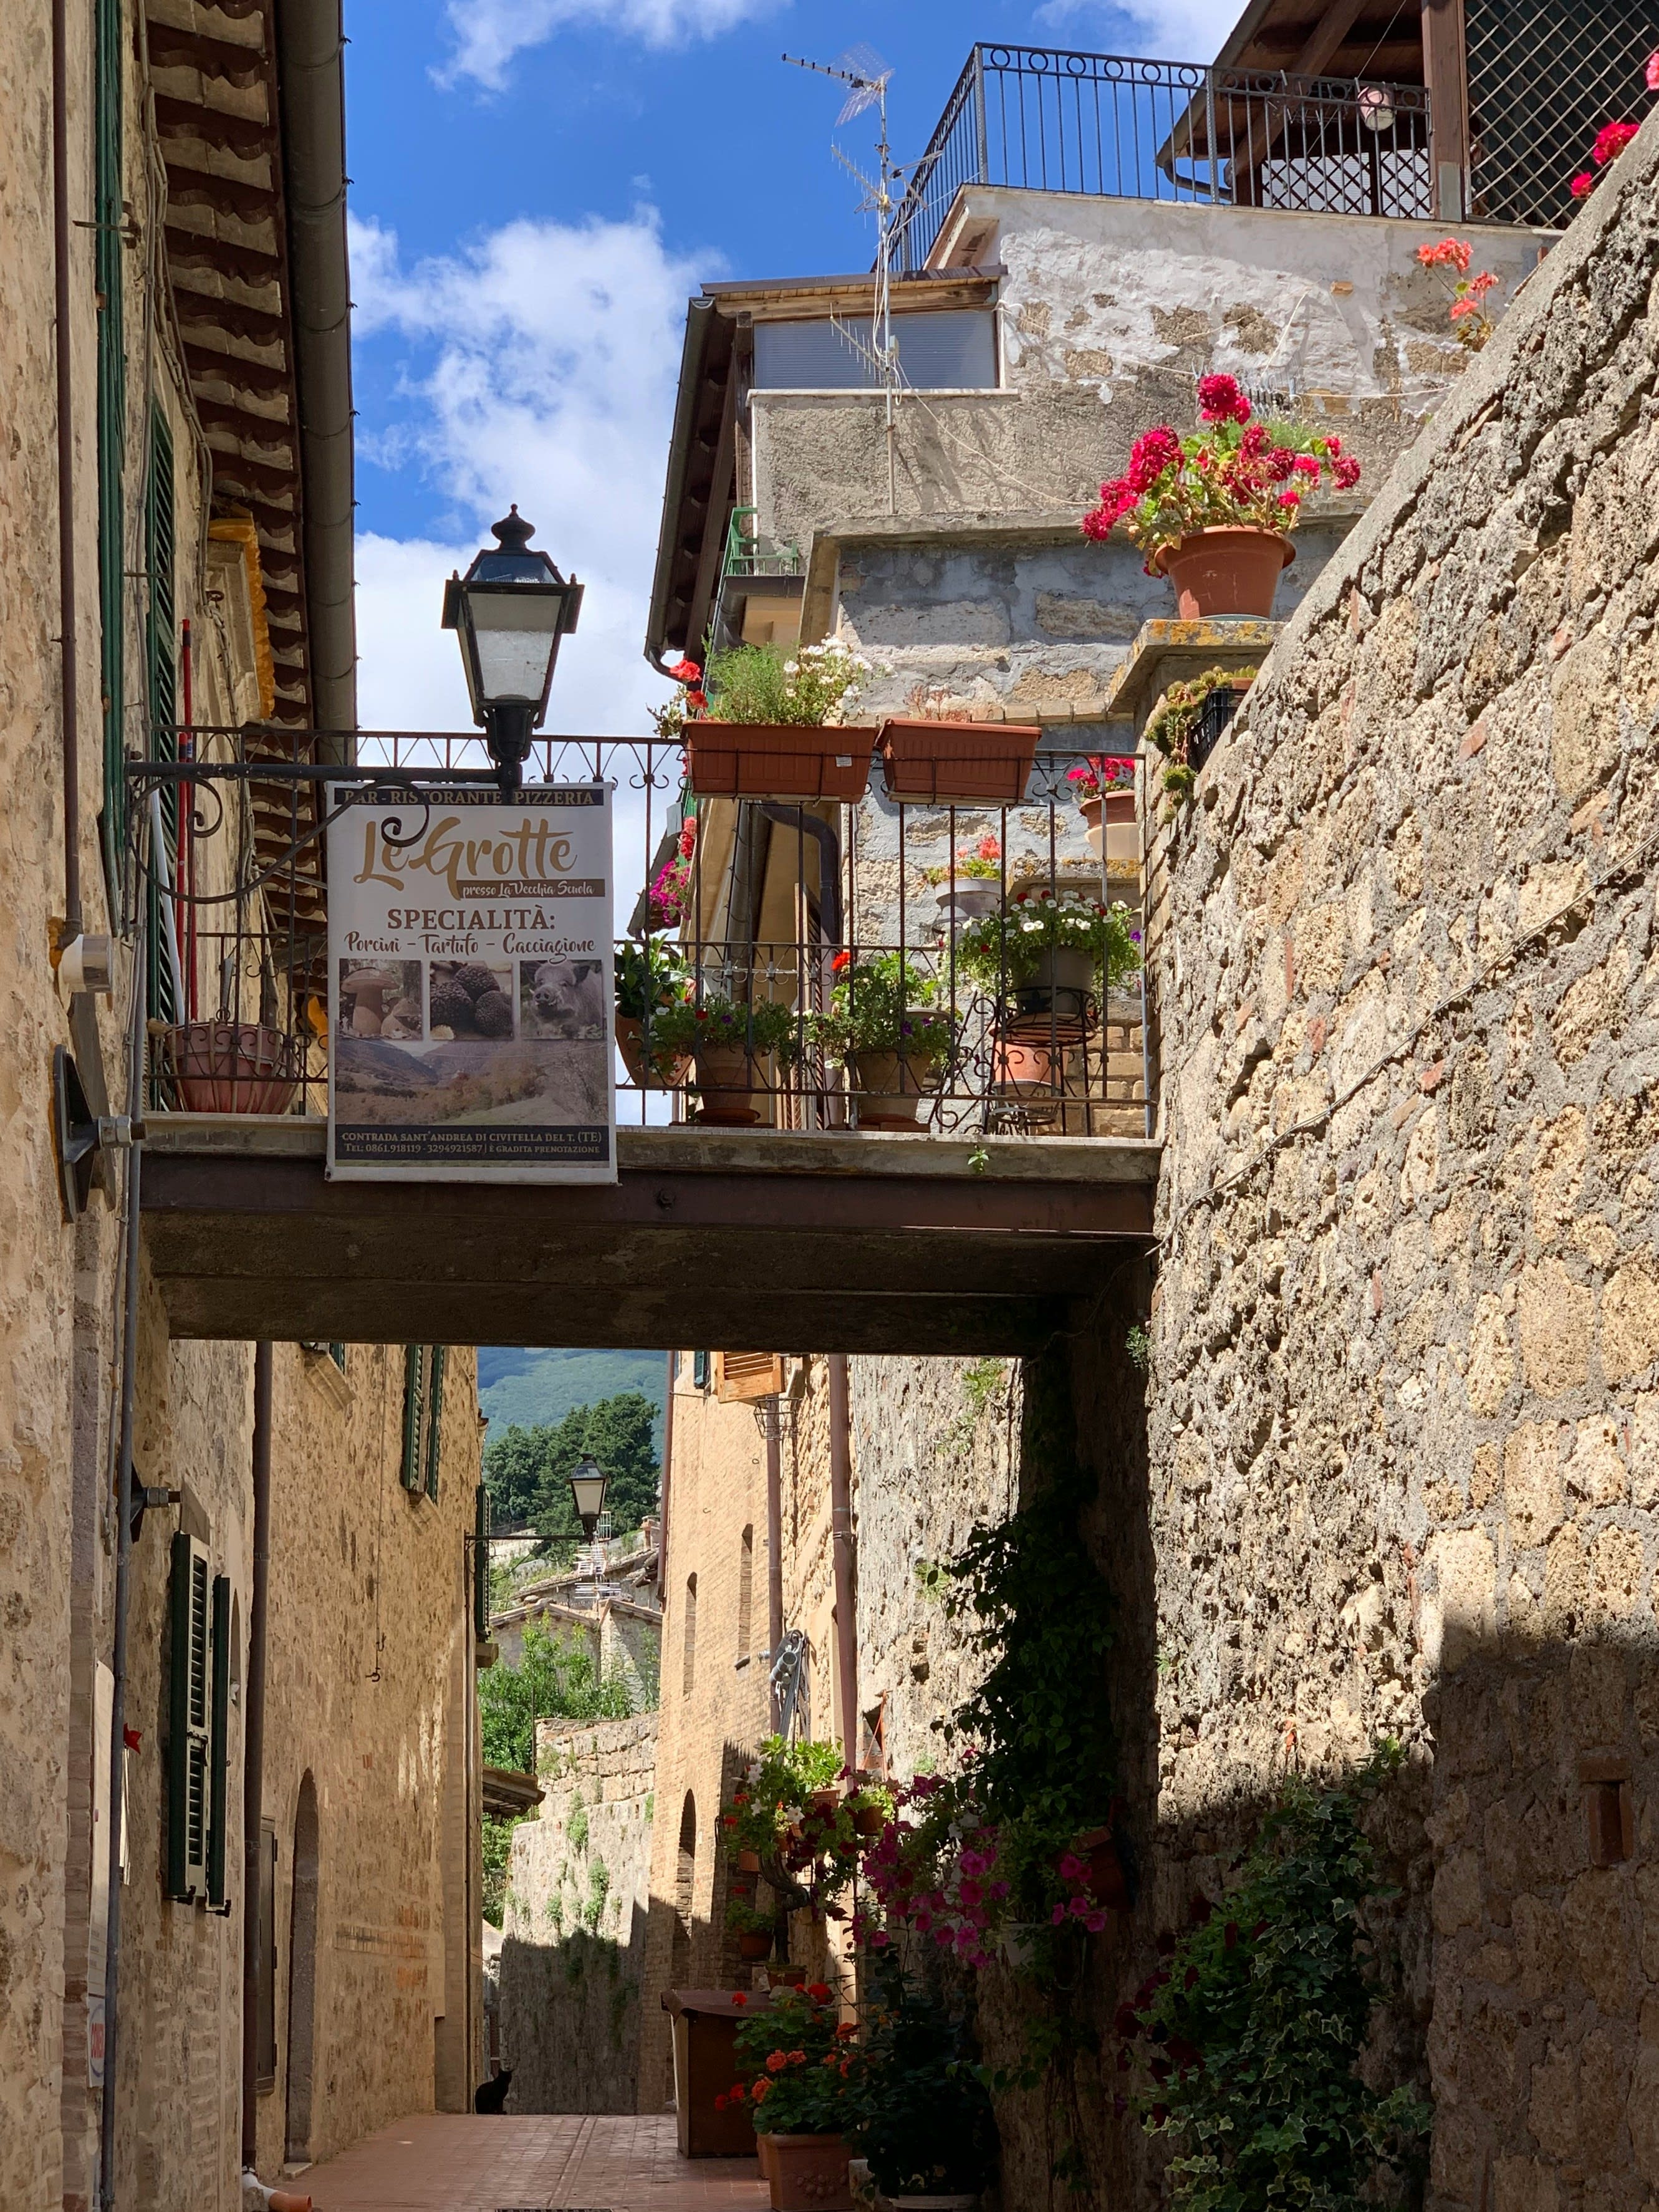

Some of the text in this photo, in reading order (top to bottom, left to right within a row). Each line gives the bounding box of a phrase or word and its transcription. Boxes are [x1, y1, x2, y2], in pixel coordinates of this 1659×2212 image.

[513, 791, 595, 804] PIZZERIA
[353, 816, 577, 900] Le Grotte
[463, 880, 594, 898] presso La Vecchia Scuola
[387, 904, 555, 930] SPECIALITÀ:
[344, 931, 402, 953] Porcini
[418, 933, 479, 956] Tartufo
[503, 933, 597, 964] Cacciagione
[341, 1132, 399, 1142] CONTRADA
[475, 1133, 487, 1142] DI
[489, 1133, 542, 1142] CIVITELLA
[546, 1133, 565, 1142] DEL
[567, 1133, 575, 1142] T.
[577, 1132, 602, 1143] (TE)
[365, 1143, 421, 1153] 0861.918119
[427, 1144, 483, 1153] 3294921587
[534, 1145, 600, 1153] PRENOTAZIONE
